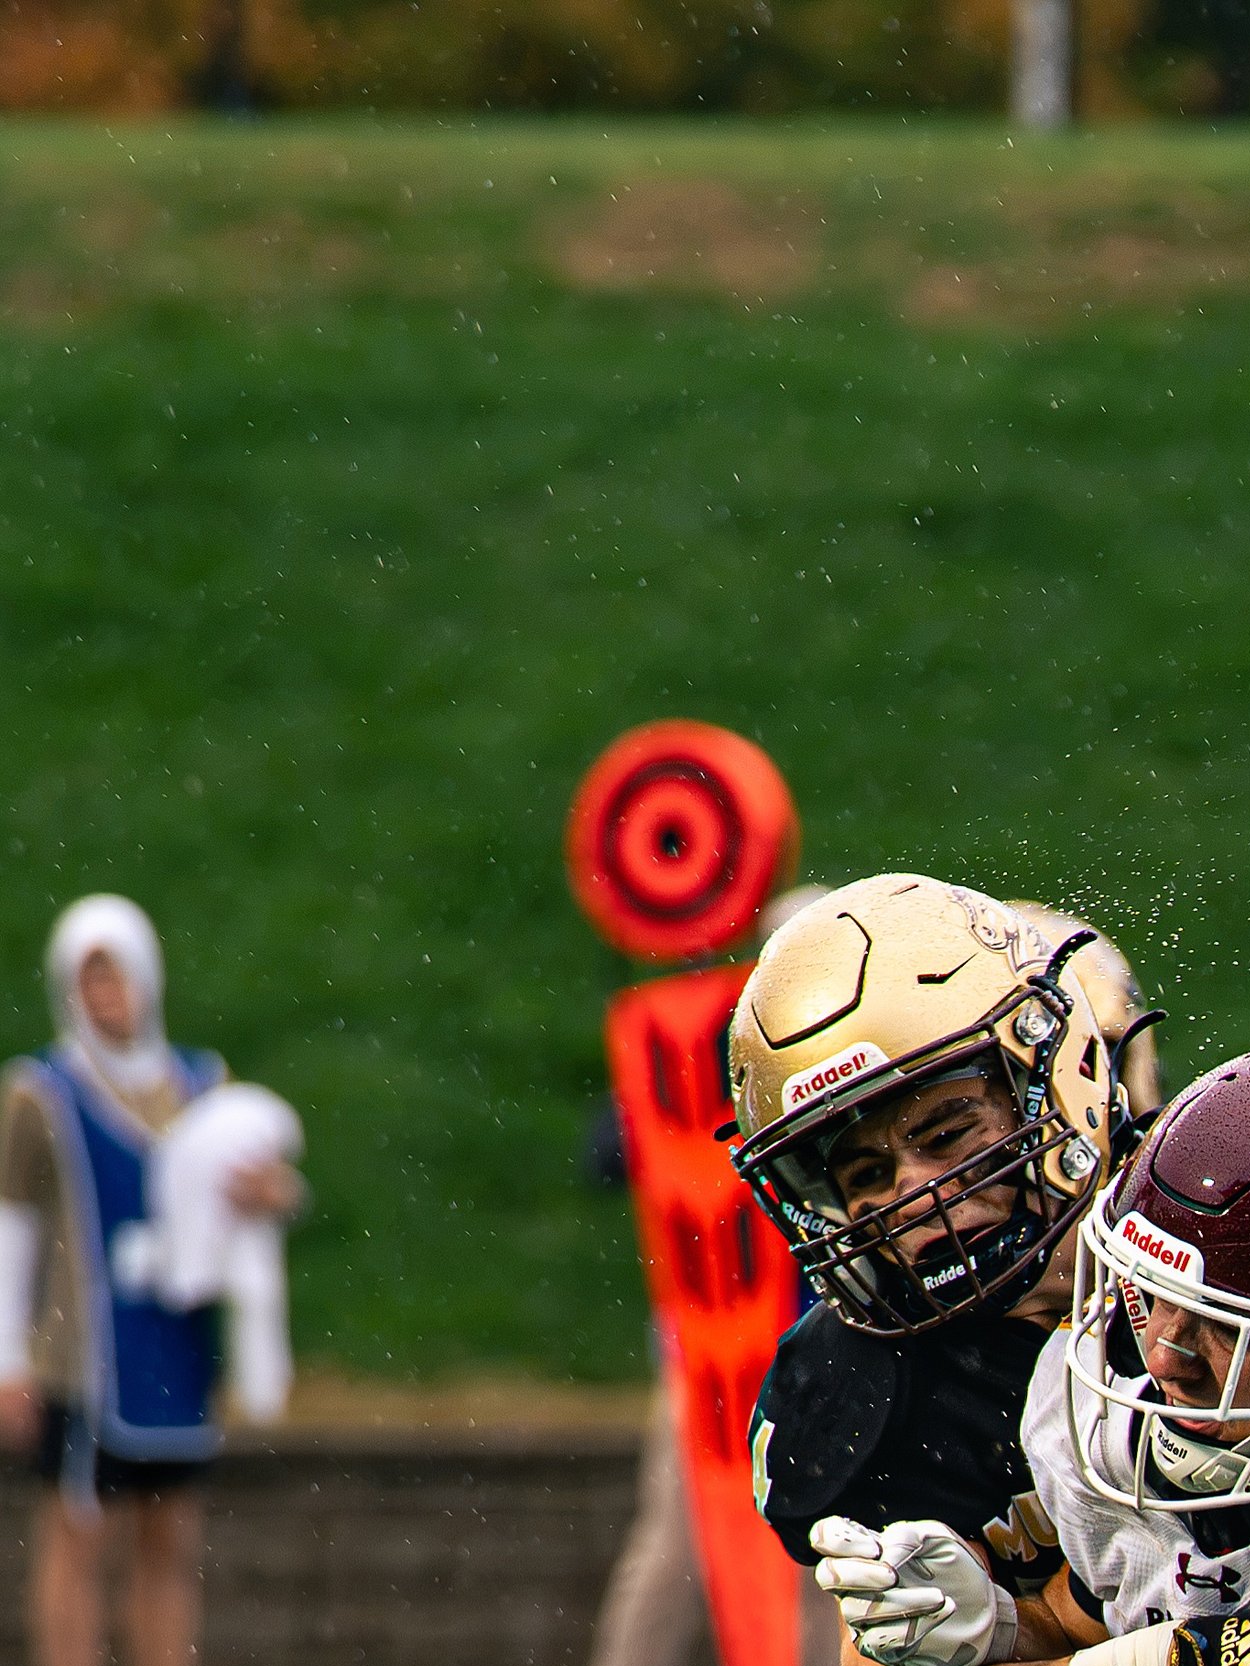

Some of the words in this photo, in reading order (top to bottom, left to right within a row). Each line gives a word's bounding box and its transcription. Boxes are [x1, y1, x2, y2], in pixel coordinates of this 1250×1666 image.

[782, 1202, 846, 1240] Ridde
[1122, 1219, 1192, 1273] Riddell
[923, 1255, 977, 1291] Riddel
